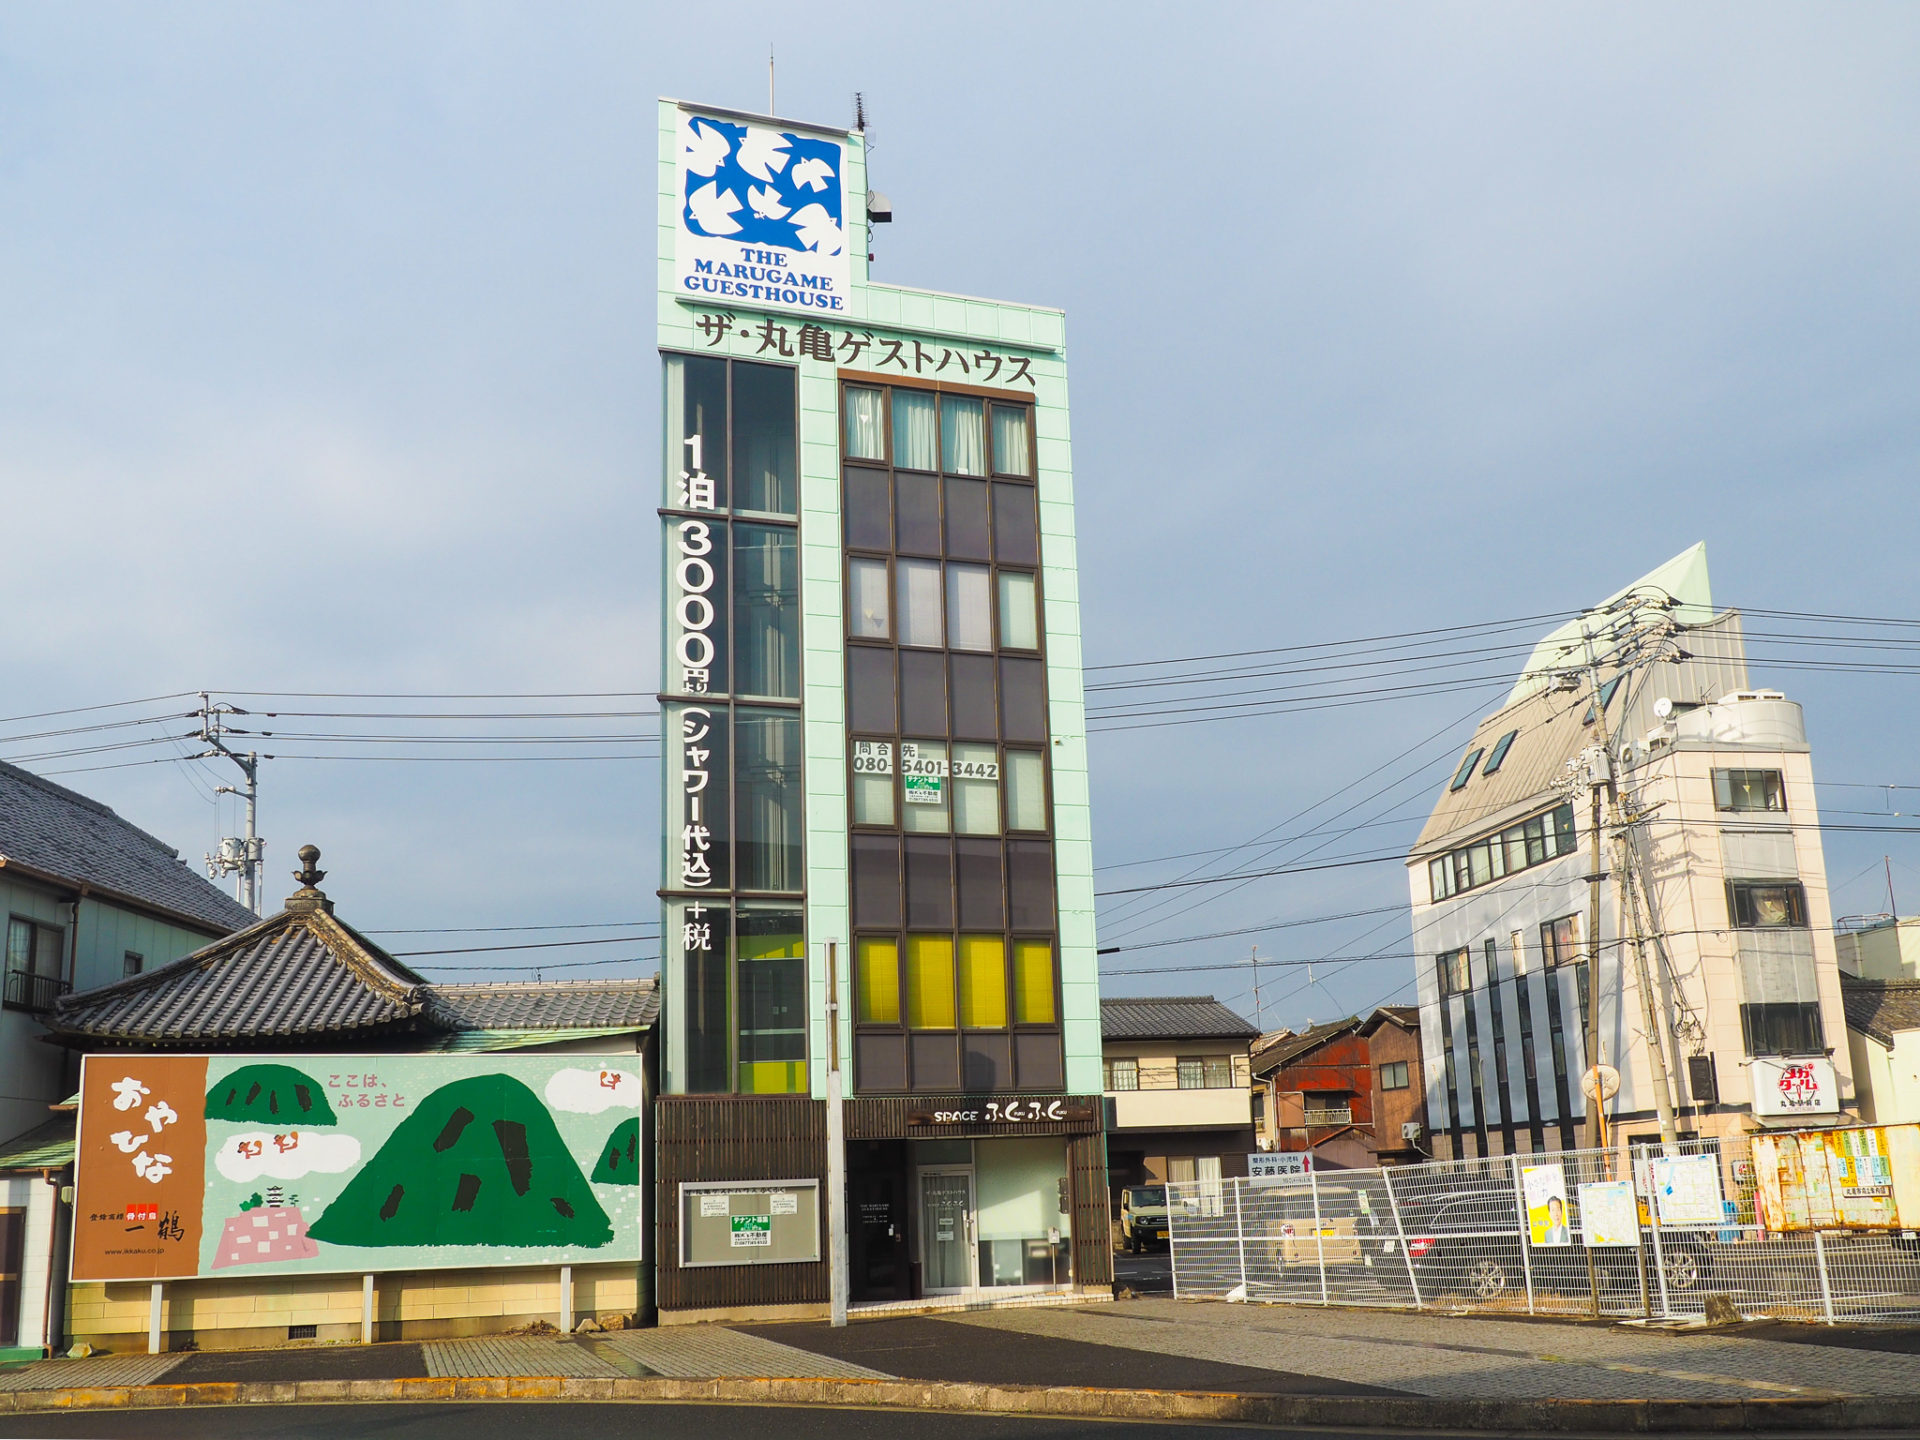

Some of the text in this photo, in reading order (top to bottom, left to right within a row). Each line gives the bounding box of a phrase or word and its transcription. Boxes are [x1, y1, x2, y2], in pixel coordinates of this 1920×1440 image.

[740, 247, 787, 268] THE
[694, 258, 834, 292] MARUGAME
[683, 275, 844, 312] GUESTHOUSE
[695, 311, 1036, 387] ザ・丸亀ゲストハウス
[337, 1092, 406, 1108] ふるさと
[934, 1100, 1064, 1122] SPACE ふくふく
[1251, 1165, 1301, 1177] 安藤医院
[734, 1216, 769, 1224] テナント募集
[104, 1247, 165, 1255] www.ikkaku.co.jp
